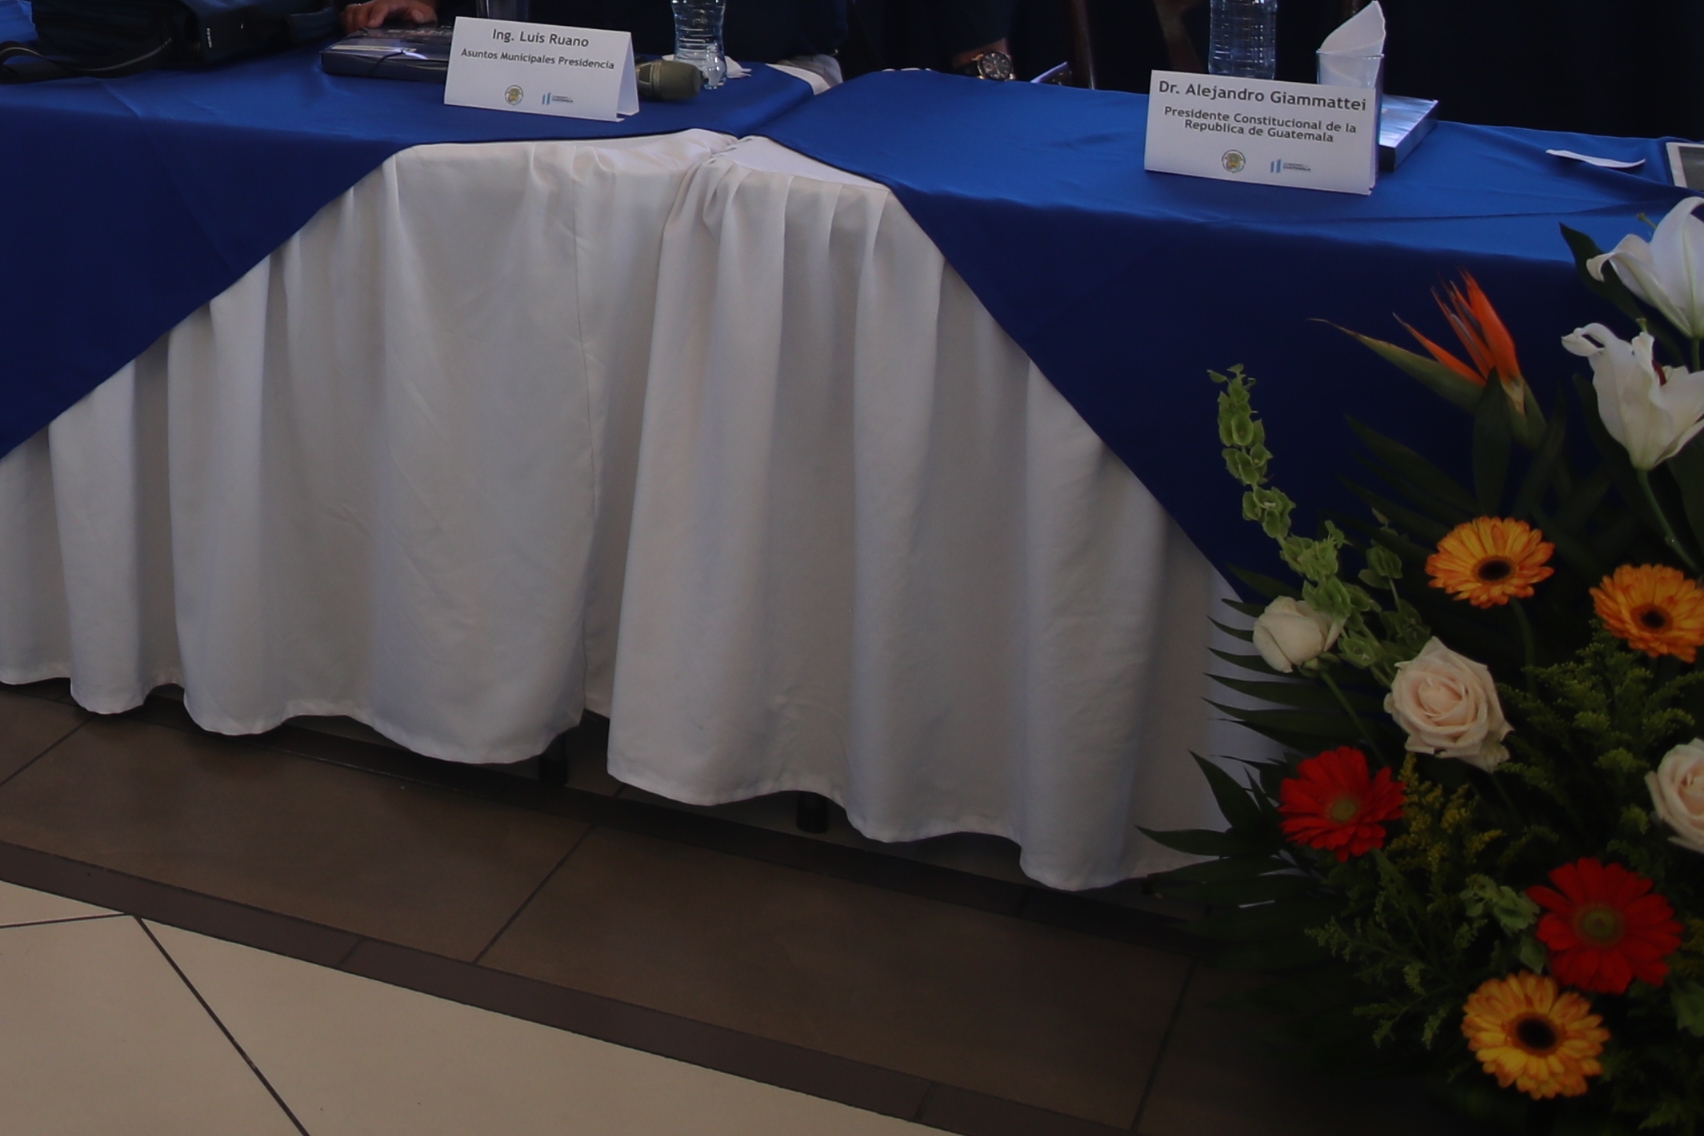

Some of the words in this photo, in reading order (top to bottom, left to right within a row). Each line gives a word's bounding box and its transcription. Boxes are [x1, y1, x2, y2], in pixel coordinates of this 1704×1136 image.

[492, 29, 515, 44] Ing.
[520, 31, 545, 44] Luis
[549, 34, 590, 48] Ruano
[460, 48, 498, 60] Asuntos
[500, 51, 556, 65] Municipales
[558, 56, 615, 70] Presidencia
[1159, 80, 1180, 95] Dr.
[1184, 83, 1265, 104] Alejandro
[1270, 90, 1367, 112] Giammattei
[1164, 106, 1230, 122] Presidente
[1233, 113, 1322, 132] Constitucional
[1326, 121, 1342, 133] de
[1345, 122, 1357, 135] la
[1185, 119, 1244, 137] Republica
[1248, 125, 1264, 137] de
[1267, 128, 1334, 144] Guatemala
